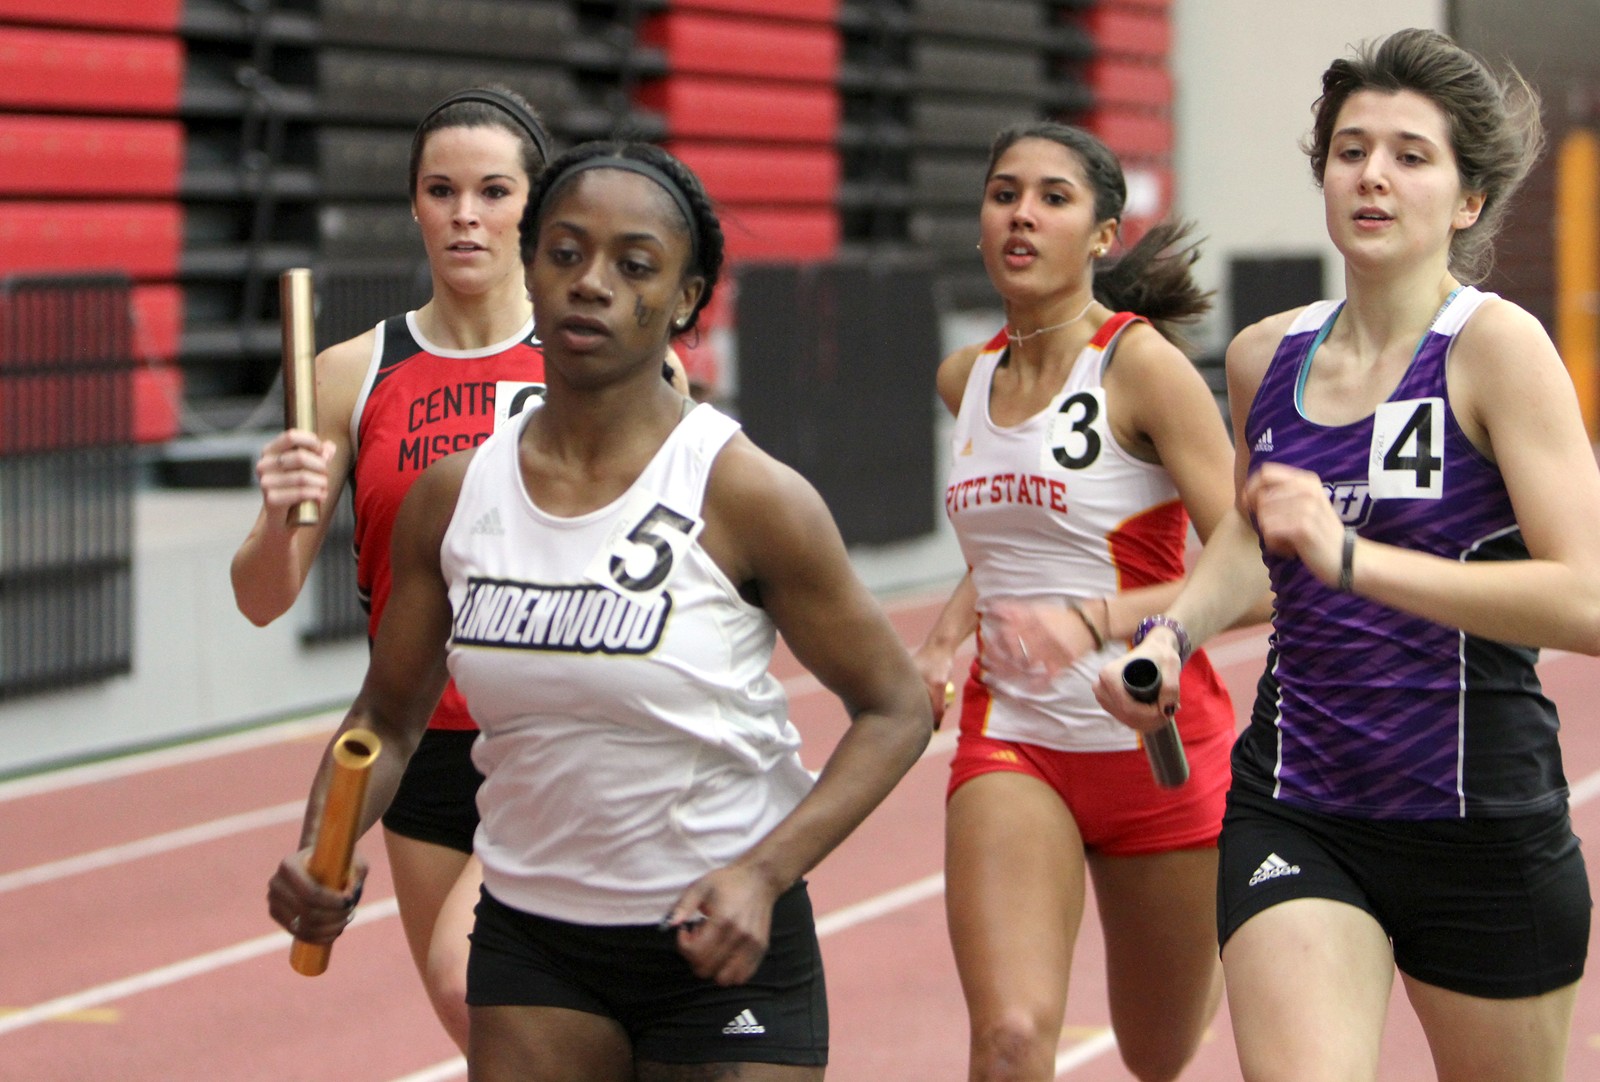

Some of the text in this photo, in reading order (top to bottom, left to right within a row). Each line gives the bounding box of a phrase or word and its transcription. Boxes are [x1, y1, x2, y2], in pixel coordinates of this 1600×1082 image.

[1052, 391, 1101, 470] 3
[1383, 403, 1442, 488] 4
[945, 473, 1067, 513] PITT STATE
[609, 502, 696, 592] 5
[454, 582, 668, 650] LINDENWOOD
[1249, 864, 1301, 886] adidas
[721, 1025, 766, 1035] adidas
